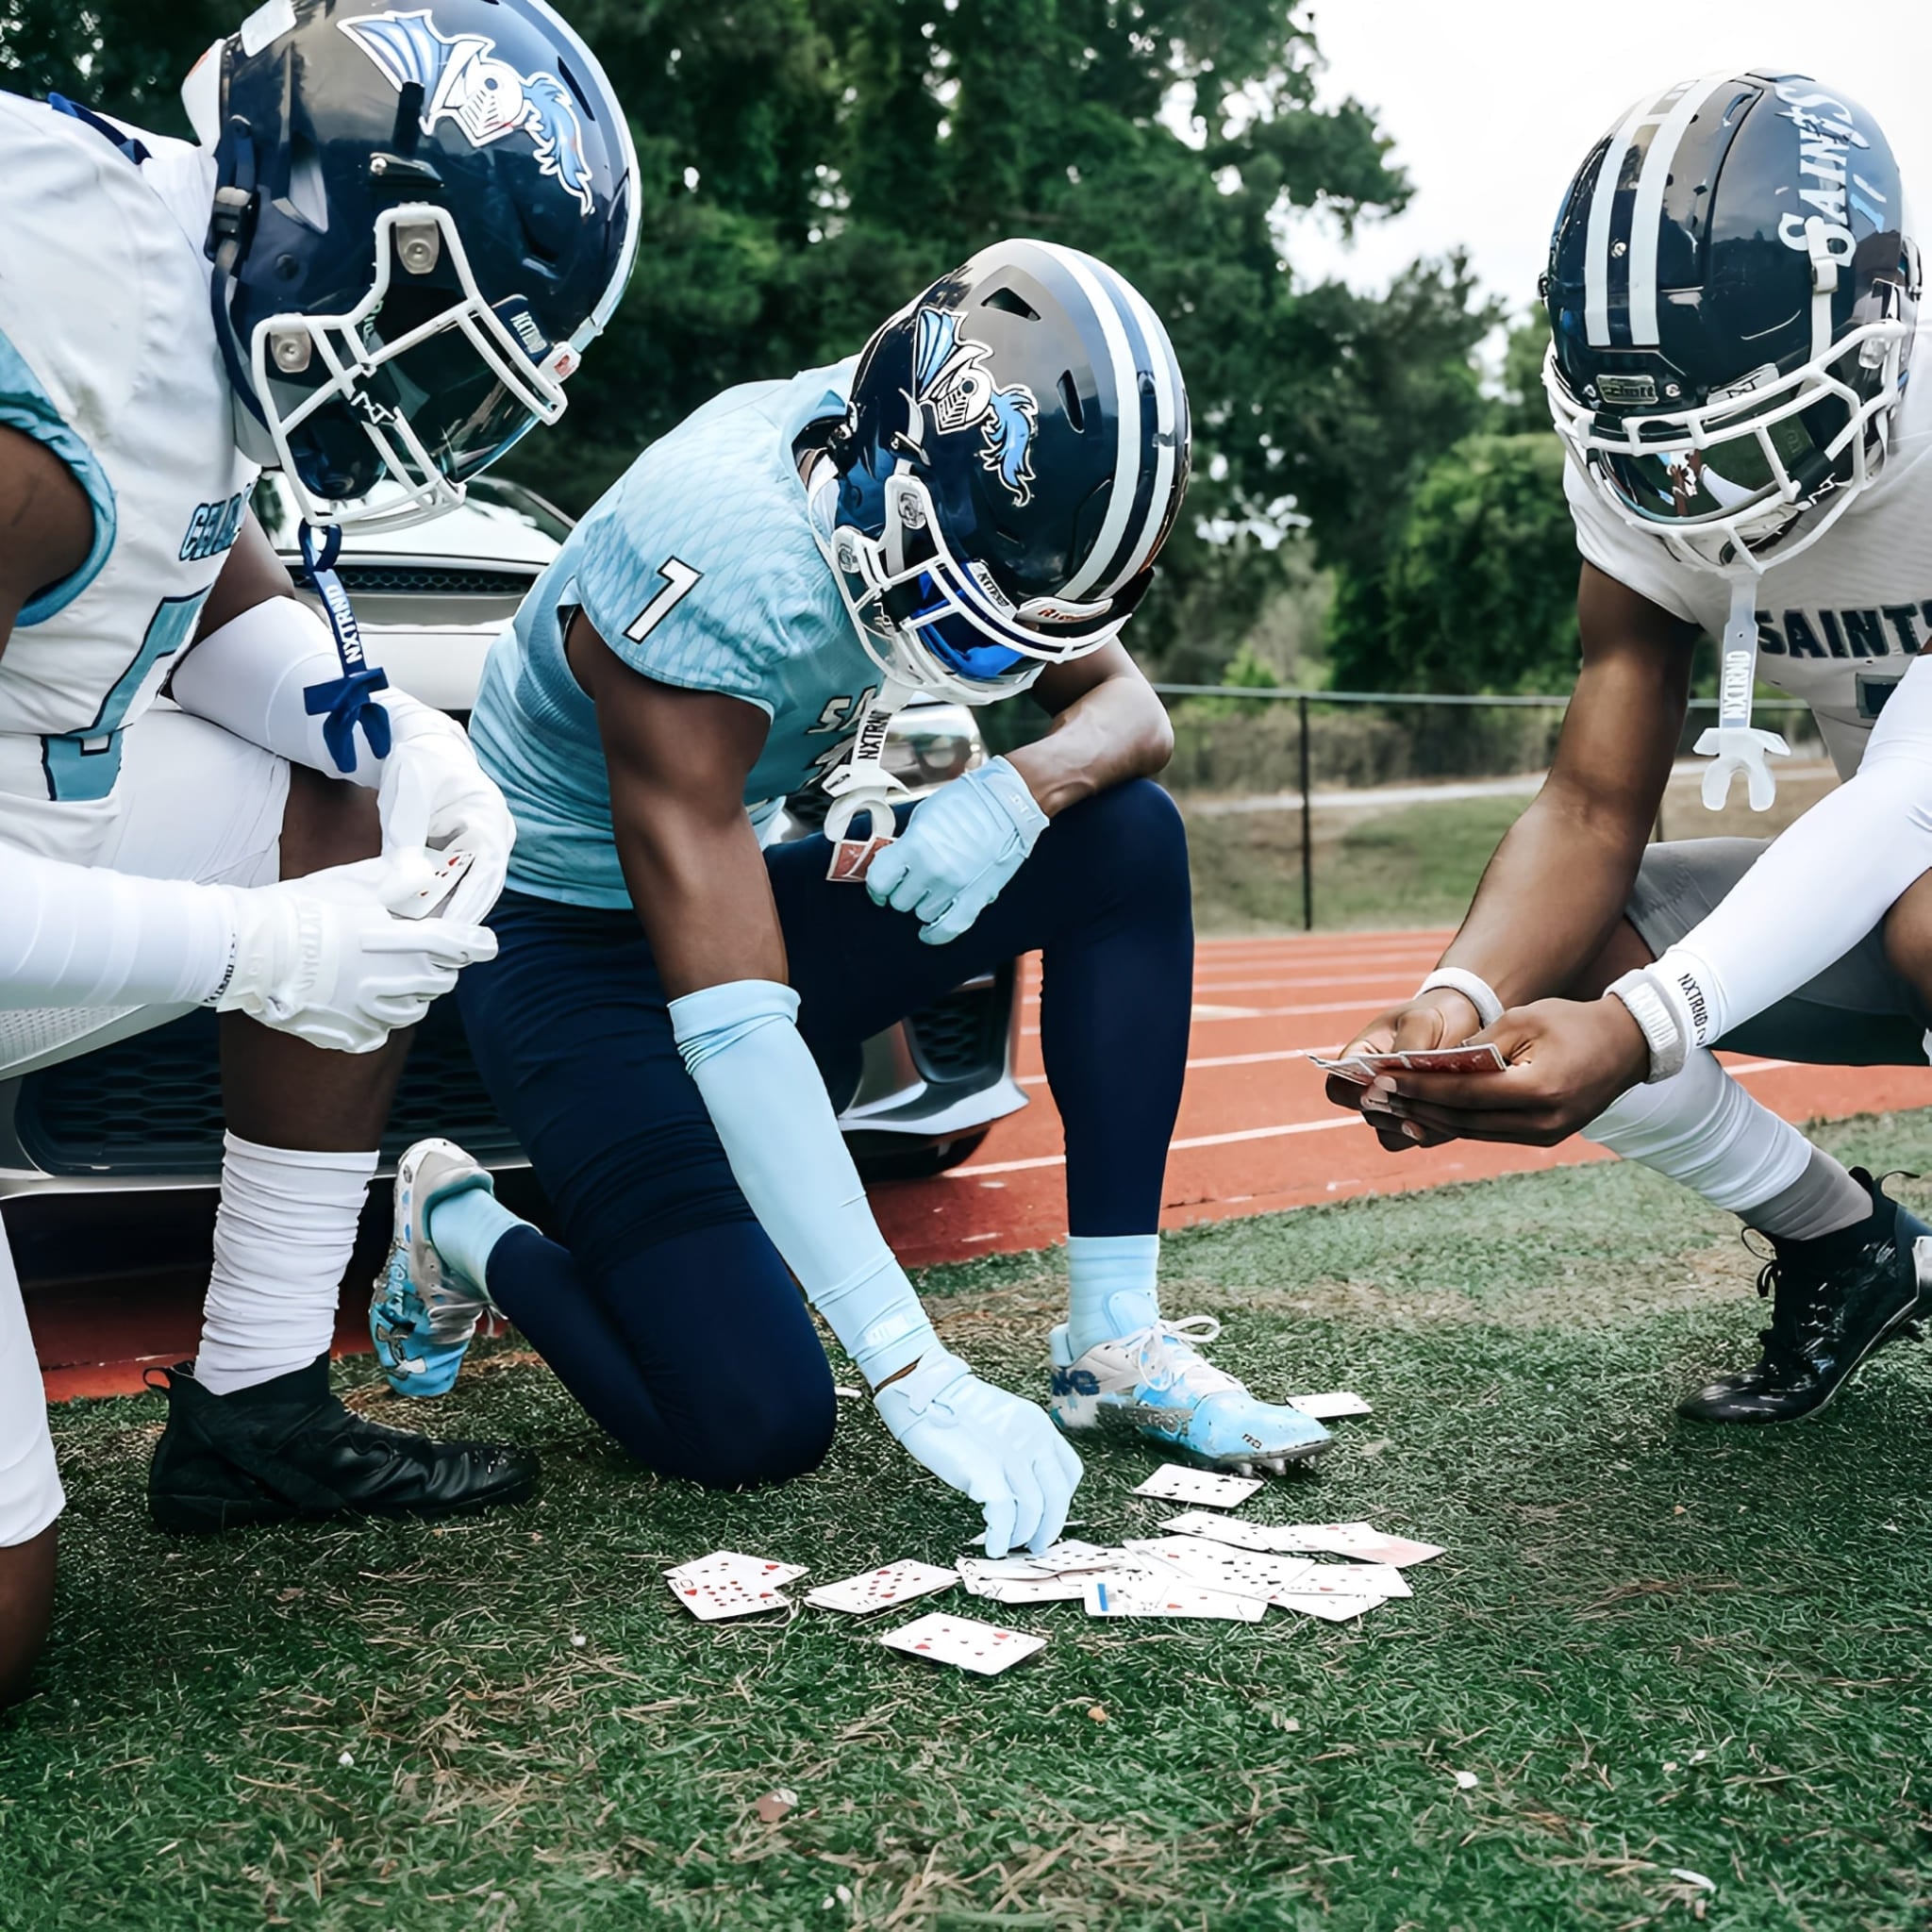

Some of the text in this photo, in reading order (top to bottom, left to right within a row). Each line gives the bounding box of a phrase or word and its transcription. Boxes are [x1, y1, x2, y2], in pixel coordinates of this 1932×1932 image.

[325, 584, 364, 664] NXTRND
[622, 555, 705, 645] 1
[1754, 598, 1932, 658] SAINT
[1723, 650, 1752, 720] NXTRND
[1677, 973, 1709, 1028] NXTRND
